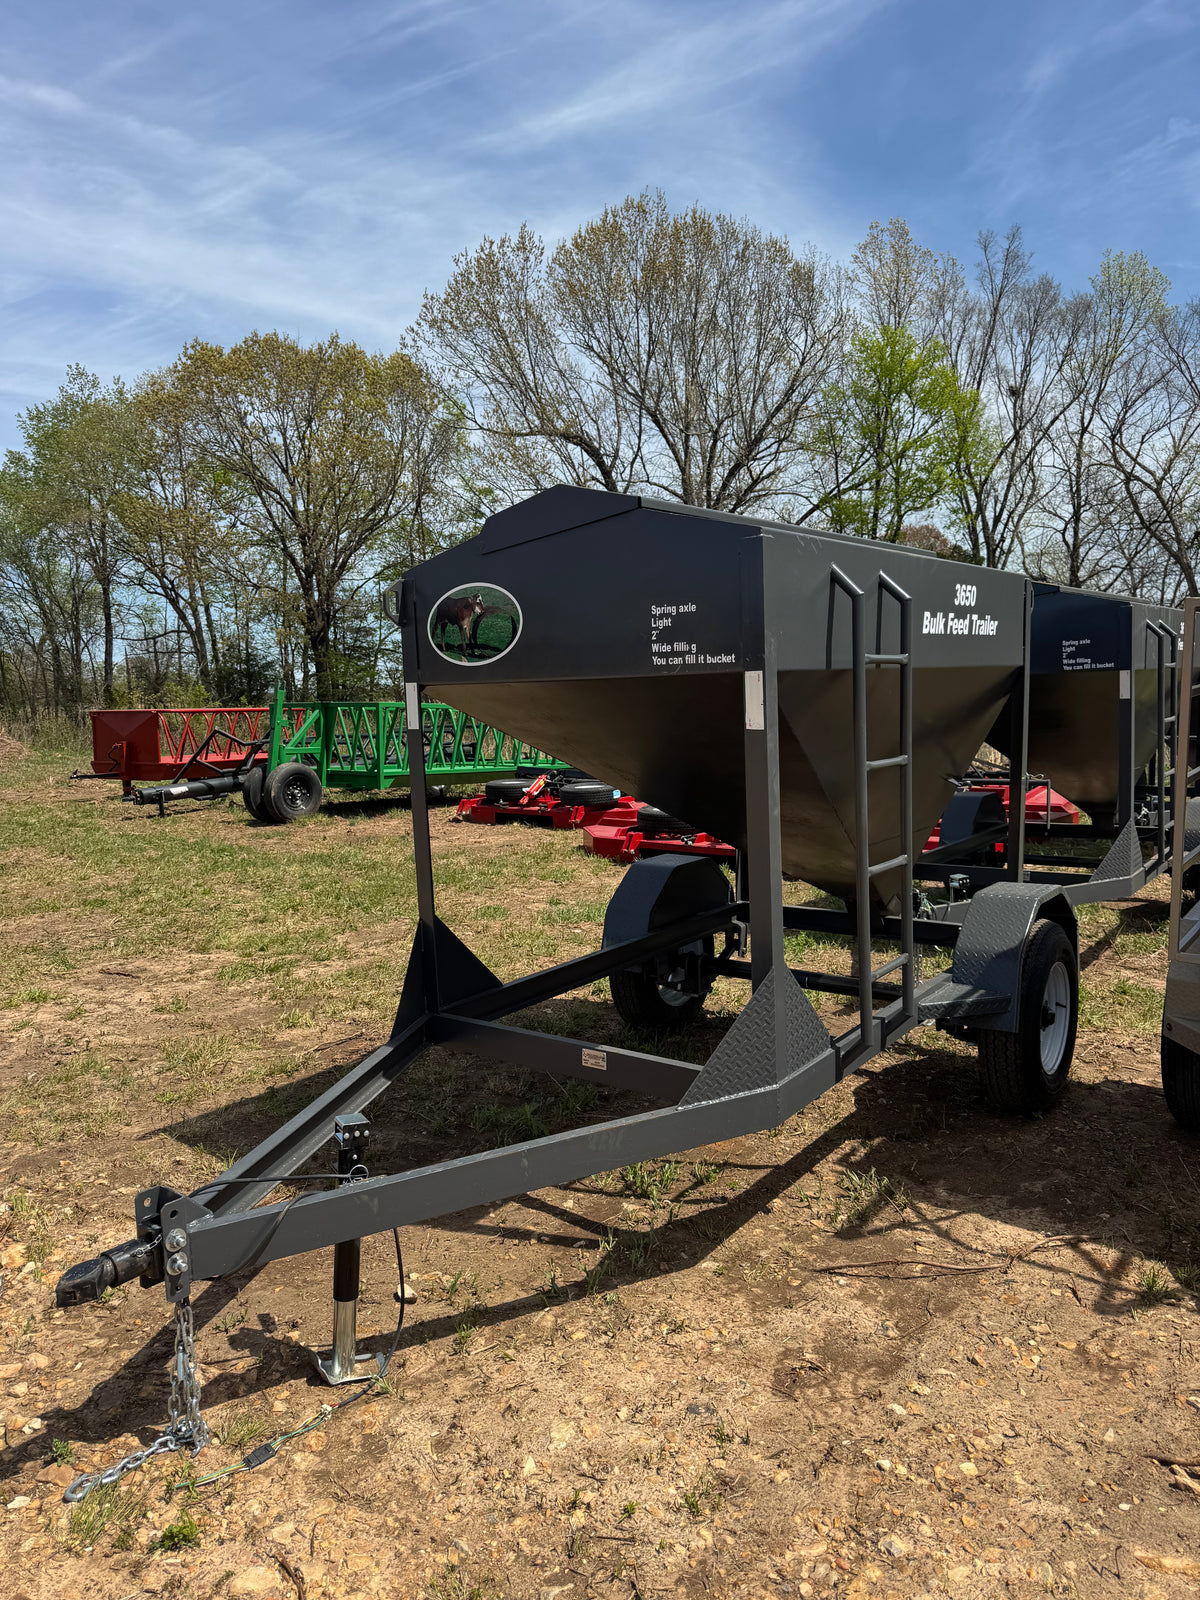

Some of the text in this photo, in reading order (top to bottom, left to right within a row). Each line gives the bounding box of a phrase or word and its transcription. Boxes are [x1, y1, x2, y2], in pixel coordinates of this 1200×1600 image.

[954, 583, 977, 607] 3650
[651, 602, 697, 616] Spring axle
[651, 617, 672, 629] Light
[922, 611, 998, 636] Bulk Feed Trailer
[651, 642, 672, 653] Wide
[652, 653, 735, 665] You can fill it bucket
